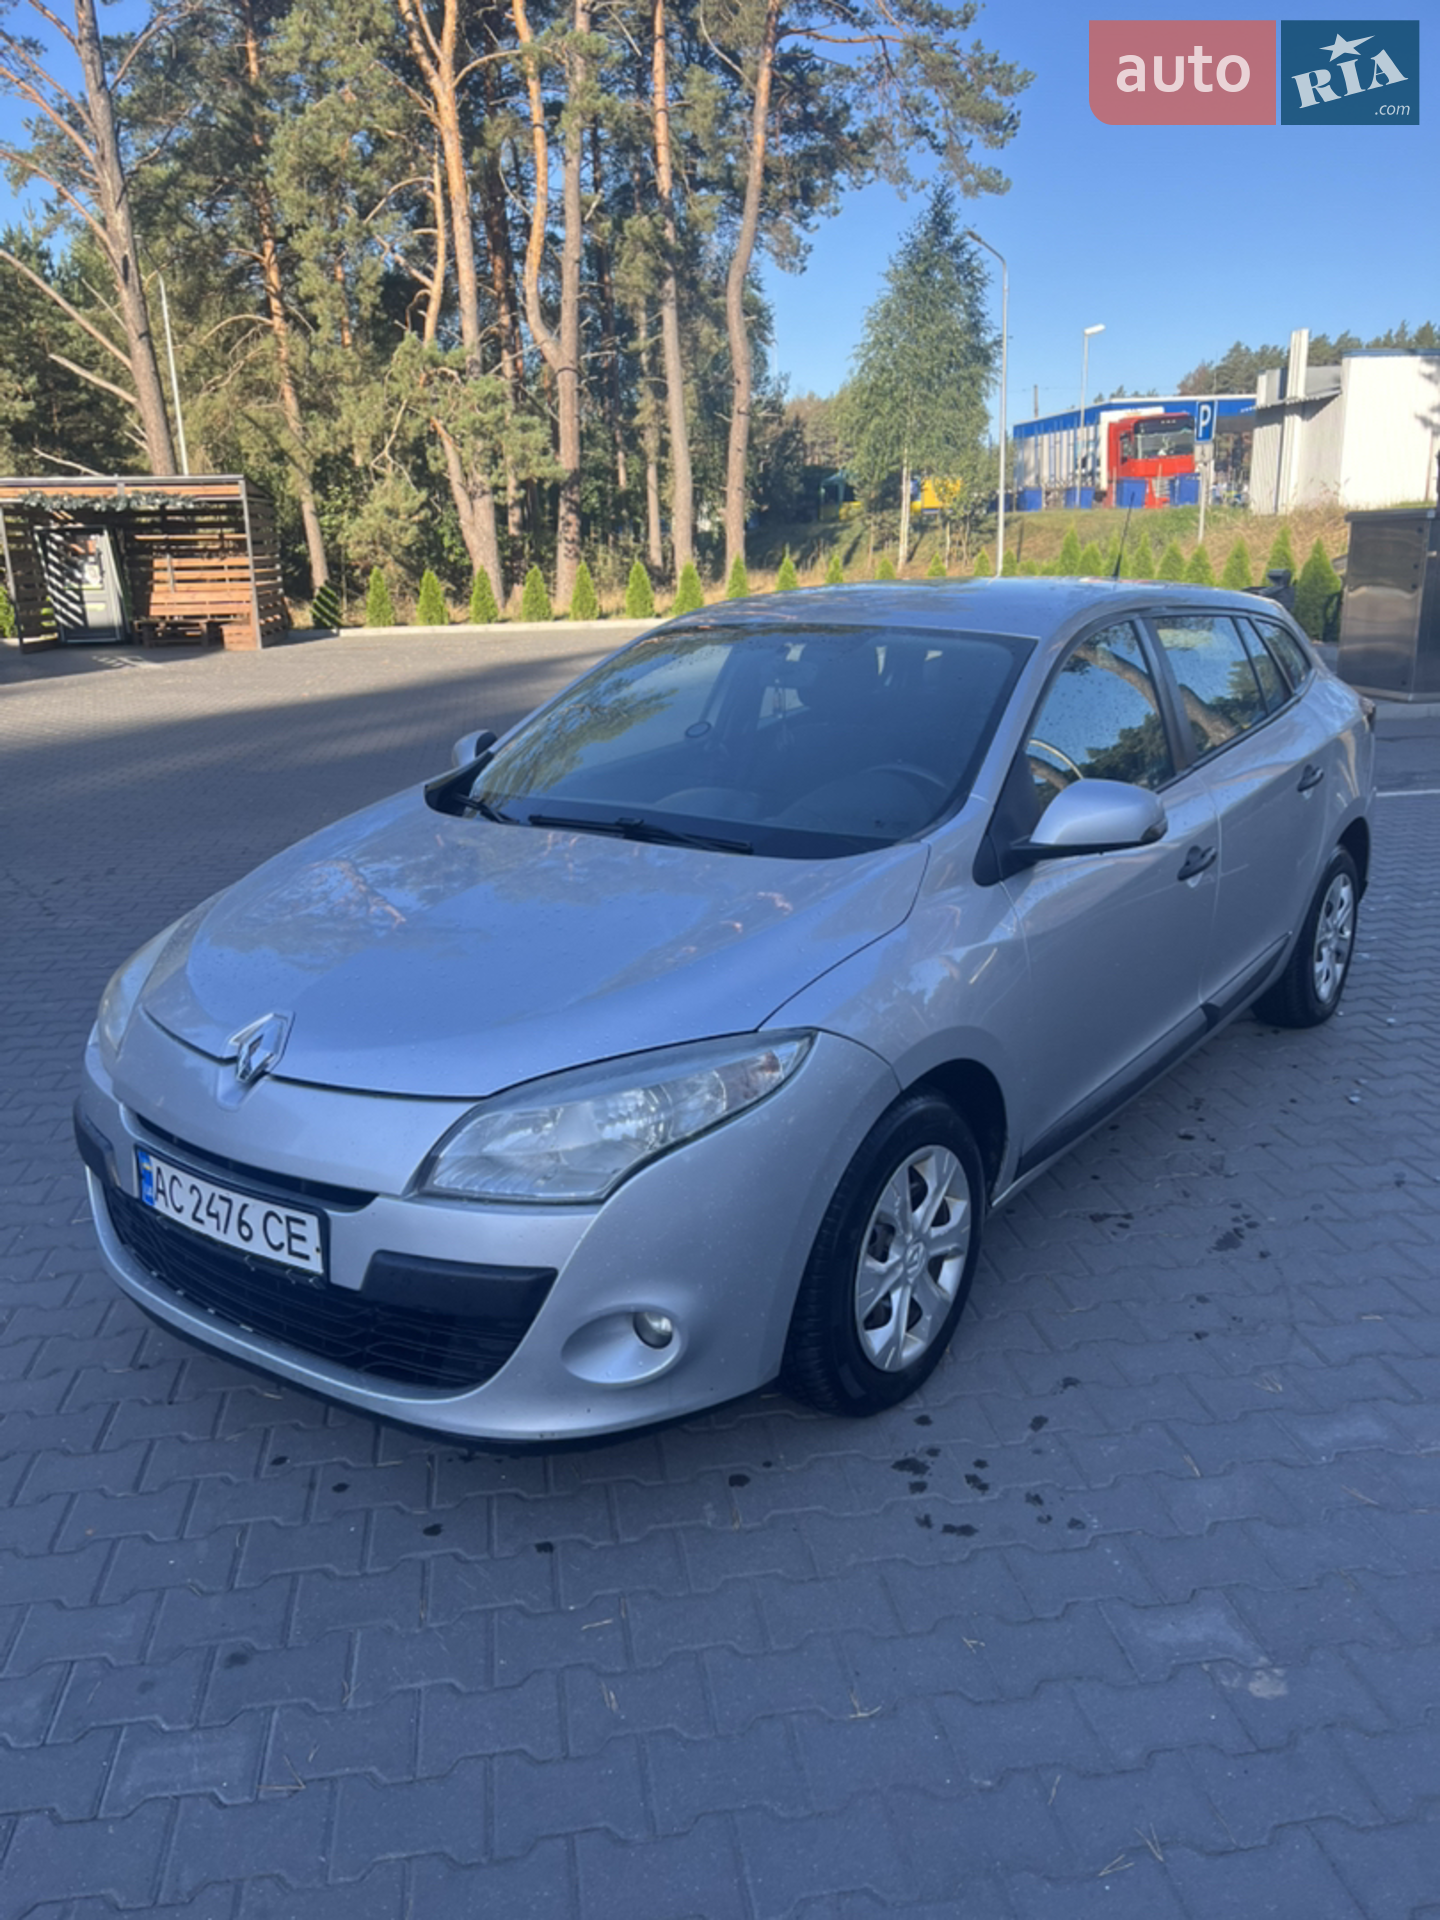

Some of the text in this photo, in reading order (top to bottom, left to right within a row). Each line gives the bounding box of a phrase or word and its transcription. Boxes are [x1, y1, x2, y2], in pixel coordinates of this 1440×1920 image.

[1198, 404, 1211, 438] P
[155, 1166, 310, 1261] AC 2476 CE
